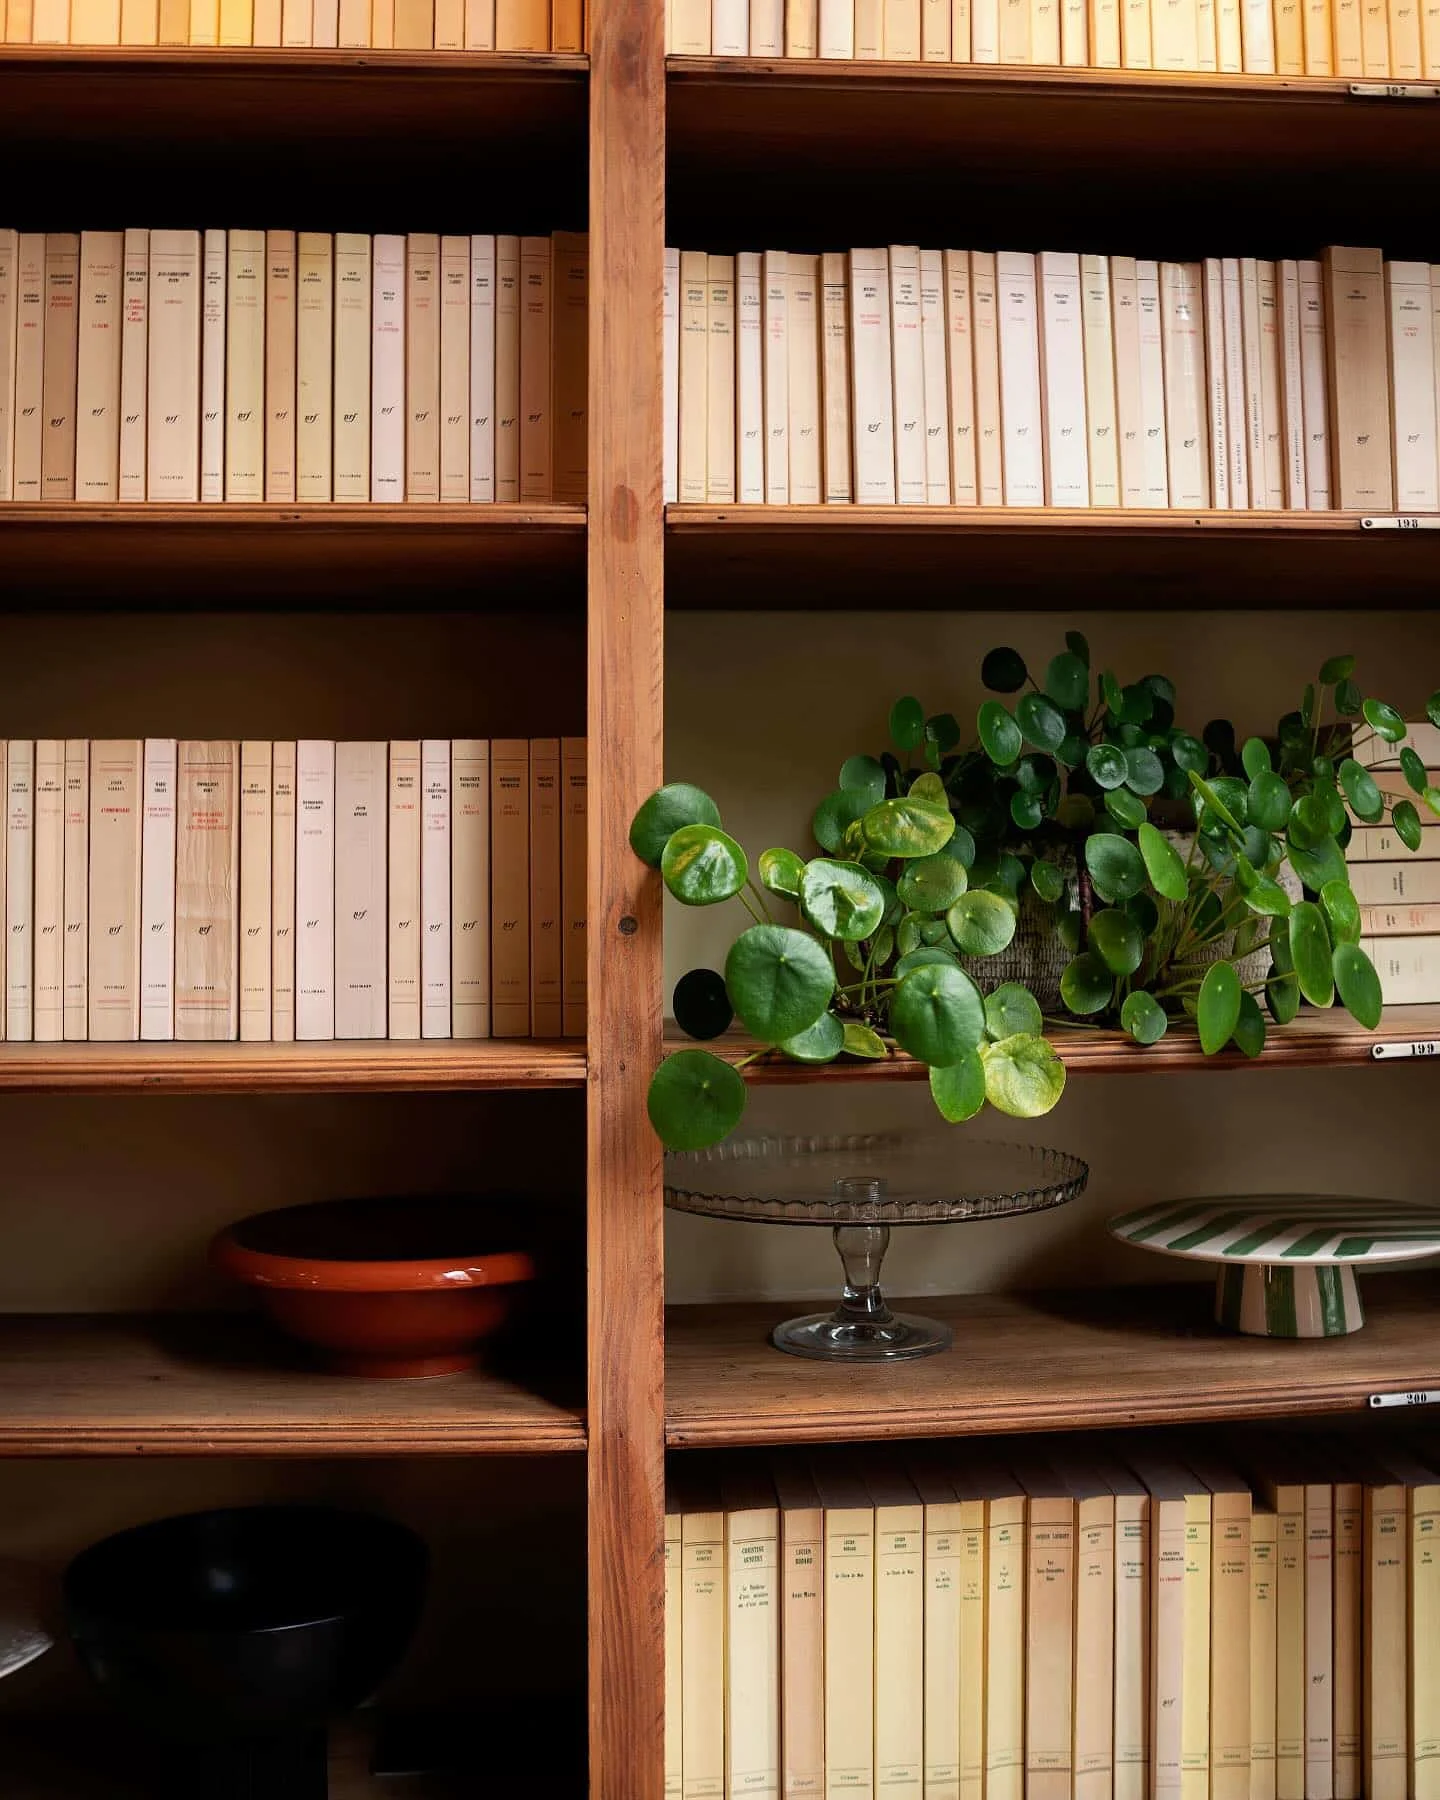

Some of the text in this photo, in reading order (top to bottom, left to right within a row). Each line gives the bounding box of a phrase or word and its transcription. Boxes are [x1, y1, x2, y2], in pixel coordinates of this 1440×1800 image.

[1386, 86, 1406, 95] 197
[1397, 519, 1418, 528] 198
[1411, 1044, 1434, 1055] 199
[1406, 1393, 1427, 1404] 200
